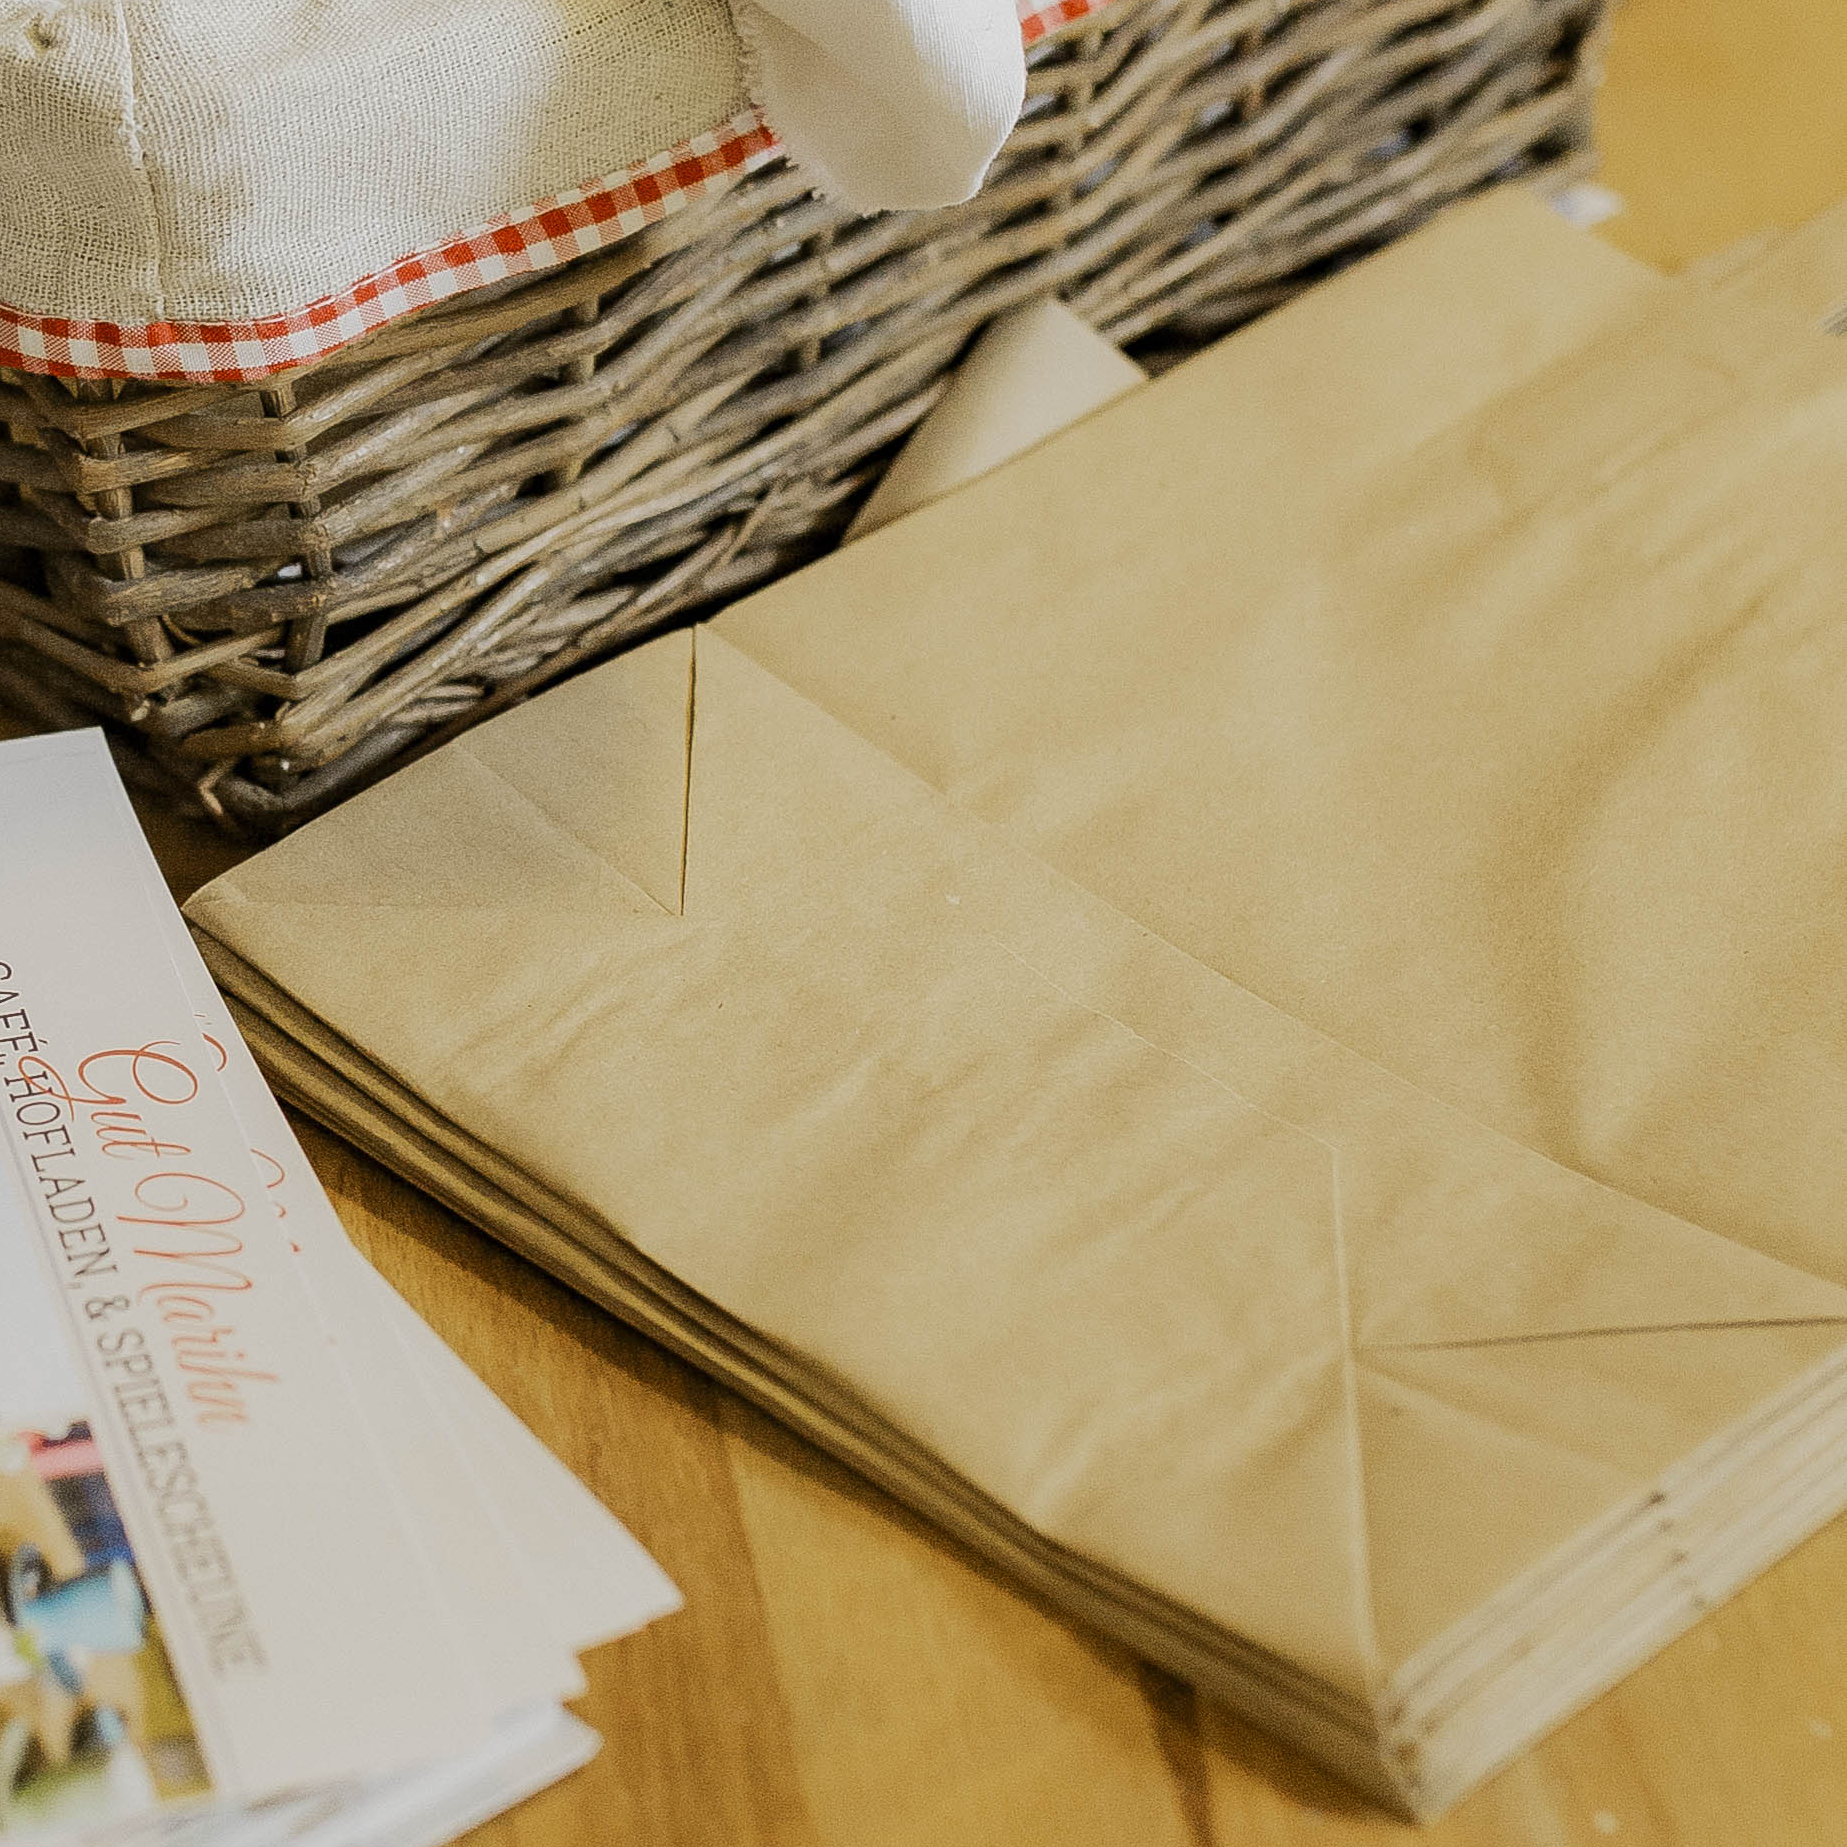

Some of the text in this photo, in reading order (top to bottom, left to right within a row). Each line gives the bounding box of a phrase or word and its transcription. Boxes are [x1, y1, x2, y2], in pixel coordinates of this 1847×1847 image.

[18, 1040, 198, 1160] Gut
[116, 1172, 281, 1430] Marihn
[84, 1294, 132, 1323] &
